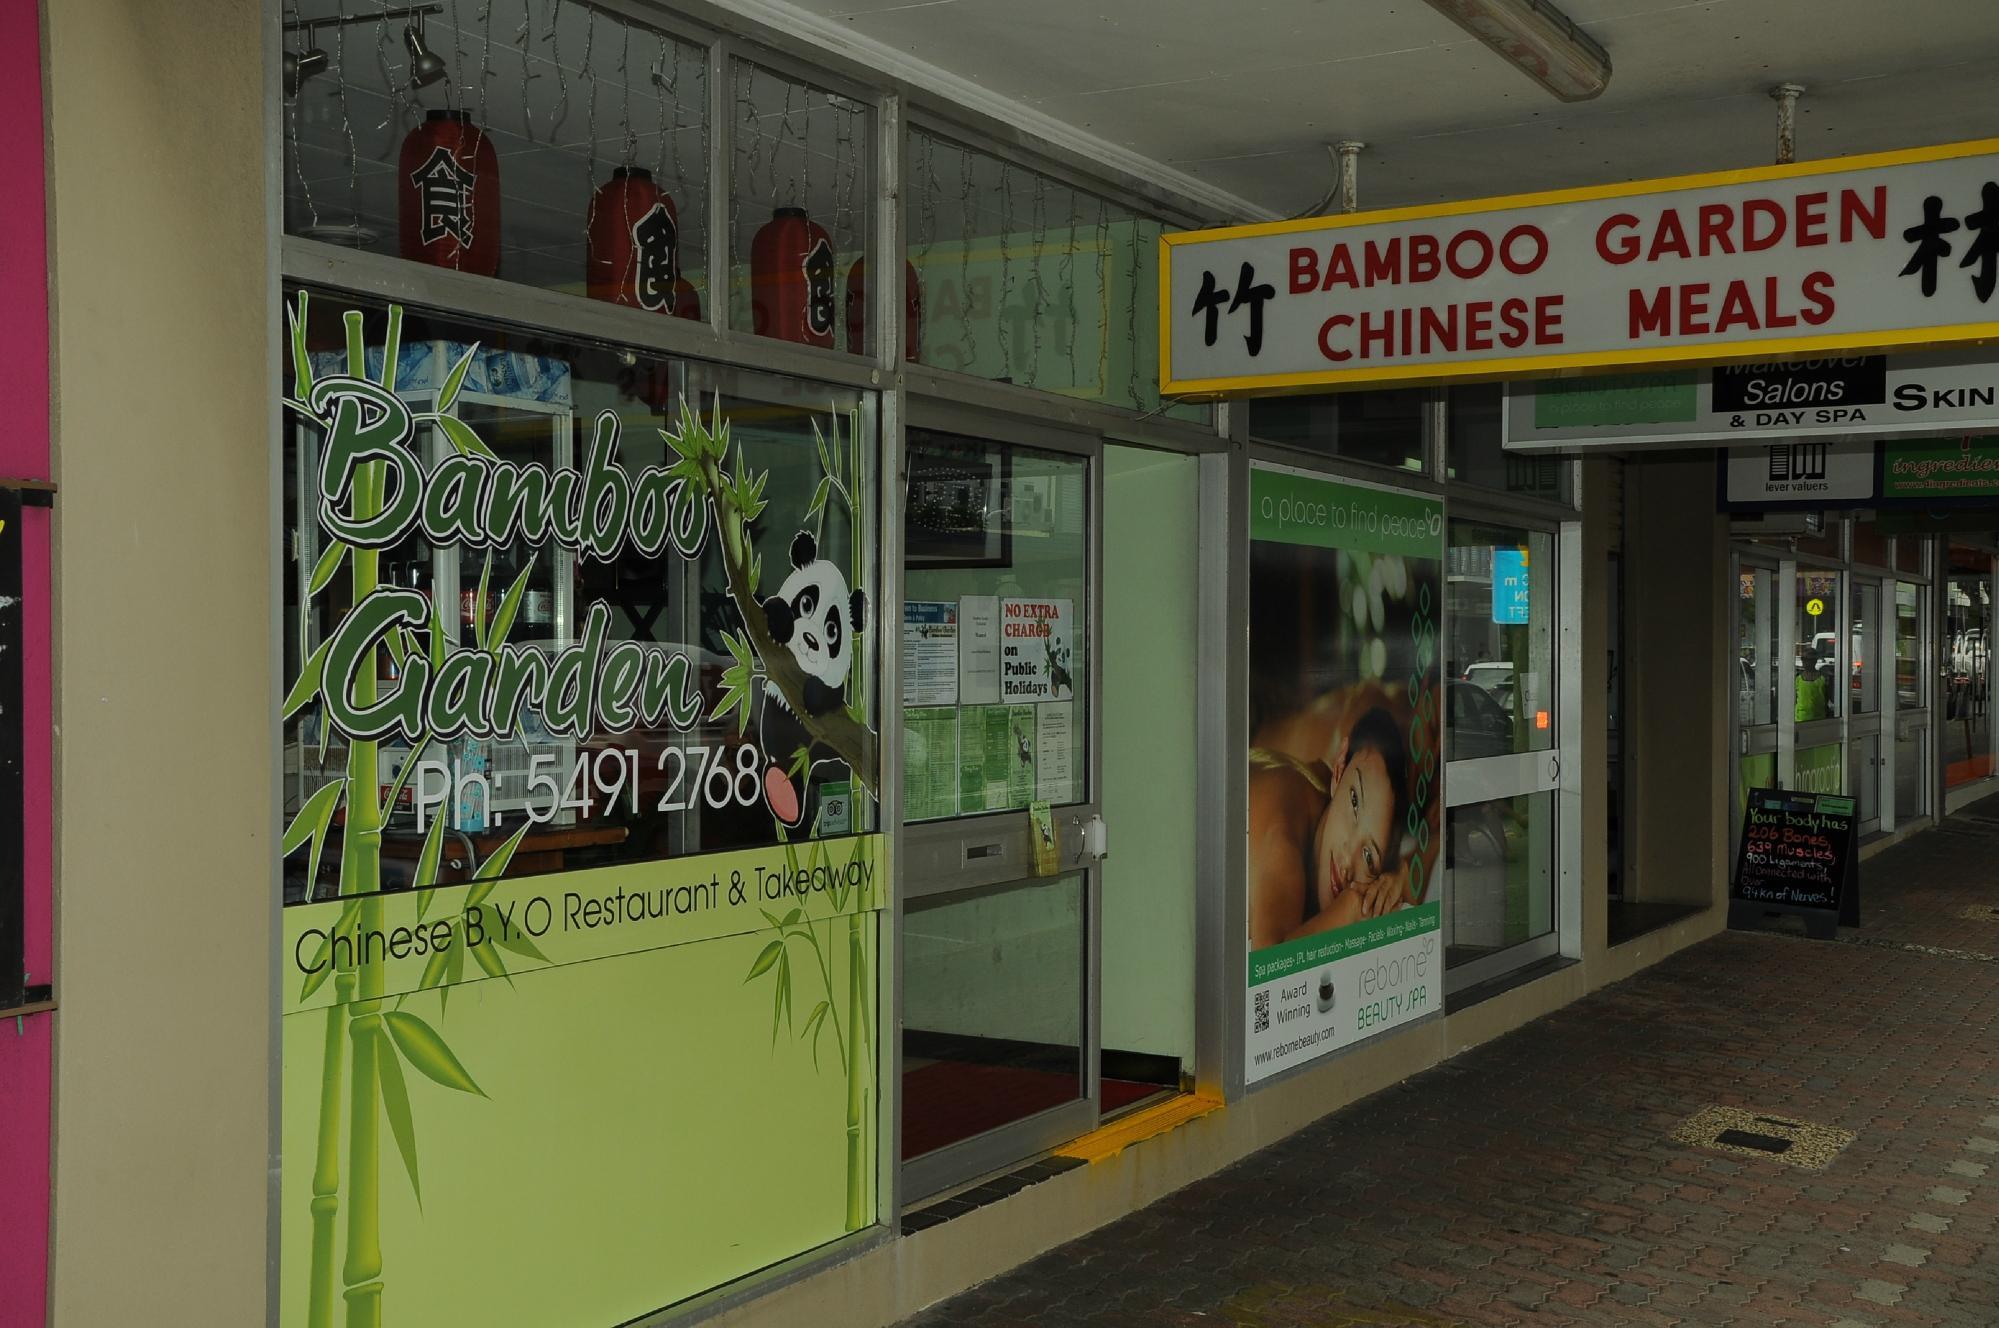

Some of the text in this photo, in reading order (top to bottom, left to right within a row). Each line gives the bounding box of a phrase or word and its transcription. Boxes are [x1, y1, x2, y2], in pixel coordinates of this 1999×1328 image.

[1289, 186, 1887, 294] BAMBOO GARDEN
[1192, 261, 1275, 357] 竹
[1318, 271, 1835, 362] CHINESE MEALS
[1744, 378, 1845, 405] Salons
[1730, 409, 1866, 428] & DAY SPA
[311, 375, 713, 565] Bamboo
[1765, 481, 1828, 492] lever valuers
[1262, 491, 1426, 543] a place to find peace
[1005, 604, 1059, 619] NO EXTRA
[1005, 623, 1050, 637] CHARGE
[1004, 646, 1018, 656] on
[320, 585, 704, 745] Garden
[1005, 662, 1037, 676] Public
[1005, 680, 1048, 697] Holidays
[417, 744, 761, 834] Ph: 5491 2768
[1747, 826, 1779, 840] 206
[1749, 807, 1849, 834] Your body has
[1775, 886, 1790, 900] of
[296, 858, 875, 974] Chinese B.Y.O Restaurant & Takeaway
[1255, 964, 1266, 979] Spa
[1306, 947, 1317, 960] hair
[1358, 952, 1427, 998] reborne
[1281, 981, 1307, 1003] Award
[1276, 1002, 1311, 1026] Winning
[1357, 985, 1427, 1031] BEAUTY SPA
[1254, 1025, 1335, 1067] www.rebornebeauty.com
